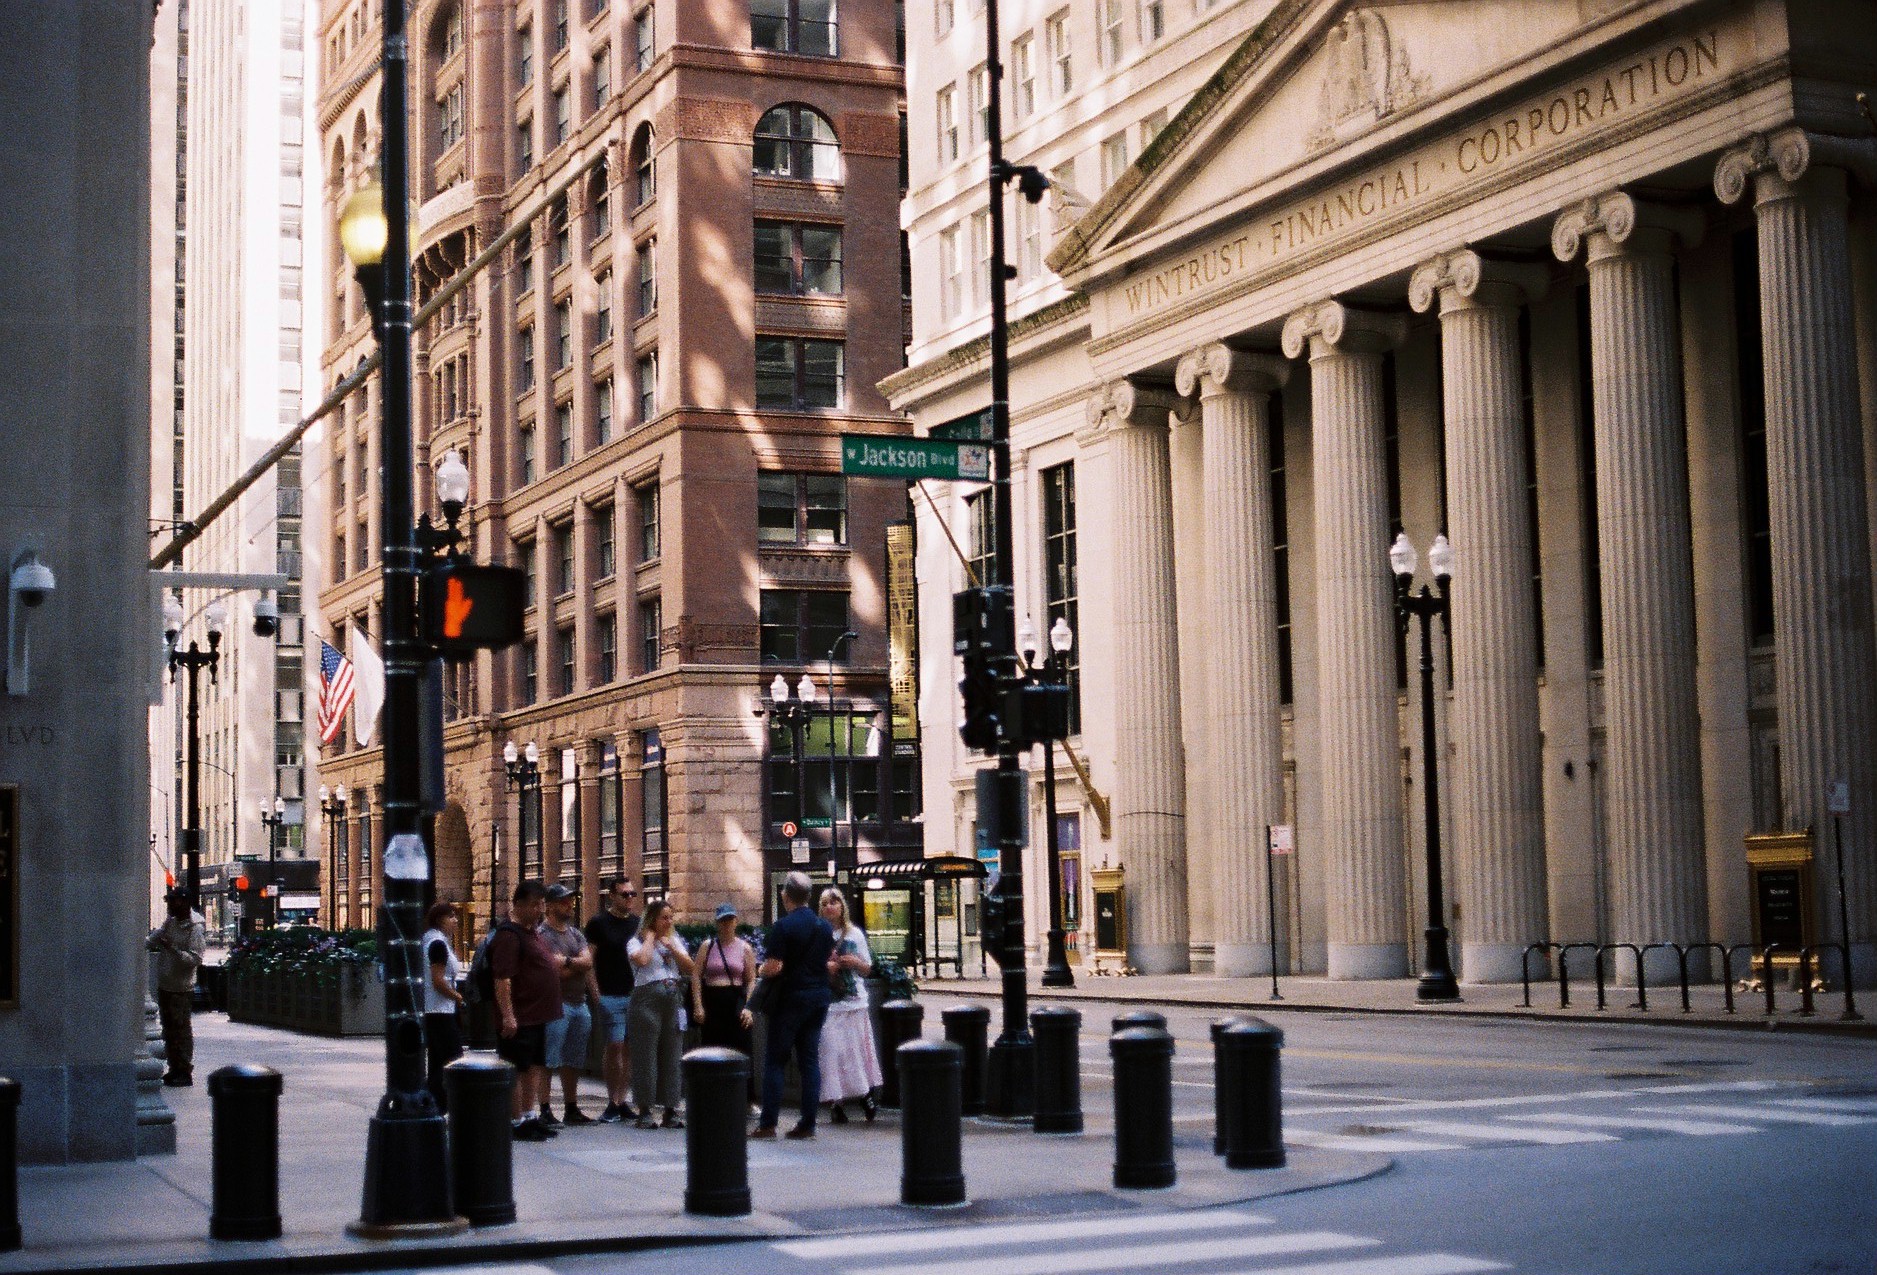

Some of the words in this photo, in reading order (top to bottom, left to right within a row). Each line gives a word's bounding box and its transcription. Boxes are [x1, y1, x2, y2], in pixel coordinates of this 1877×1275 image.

[1124, 236, 1249, 314] WINTRUST
[1269, 160, 1431, 257] FINANCIAL
[1457, 31, 1720, 174] CORPORATION
[859, 443, 927, 469] Jackson
[930, 452, 956, 467] Blvd
[2, 725, 55, 745] LVD
